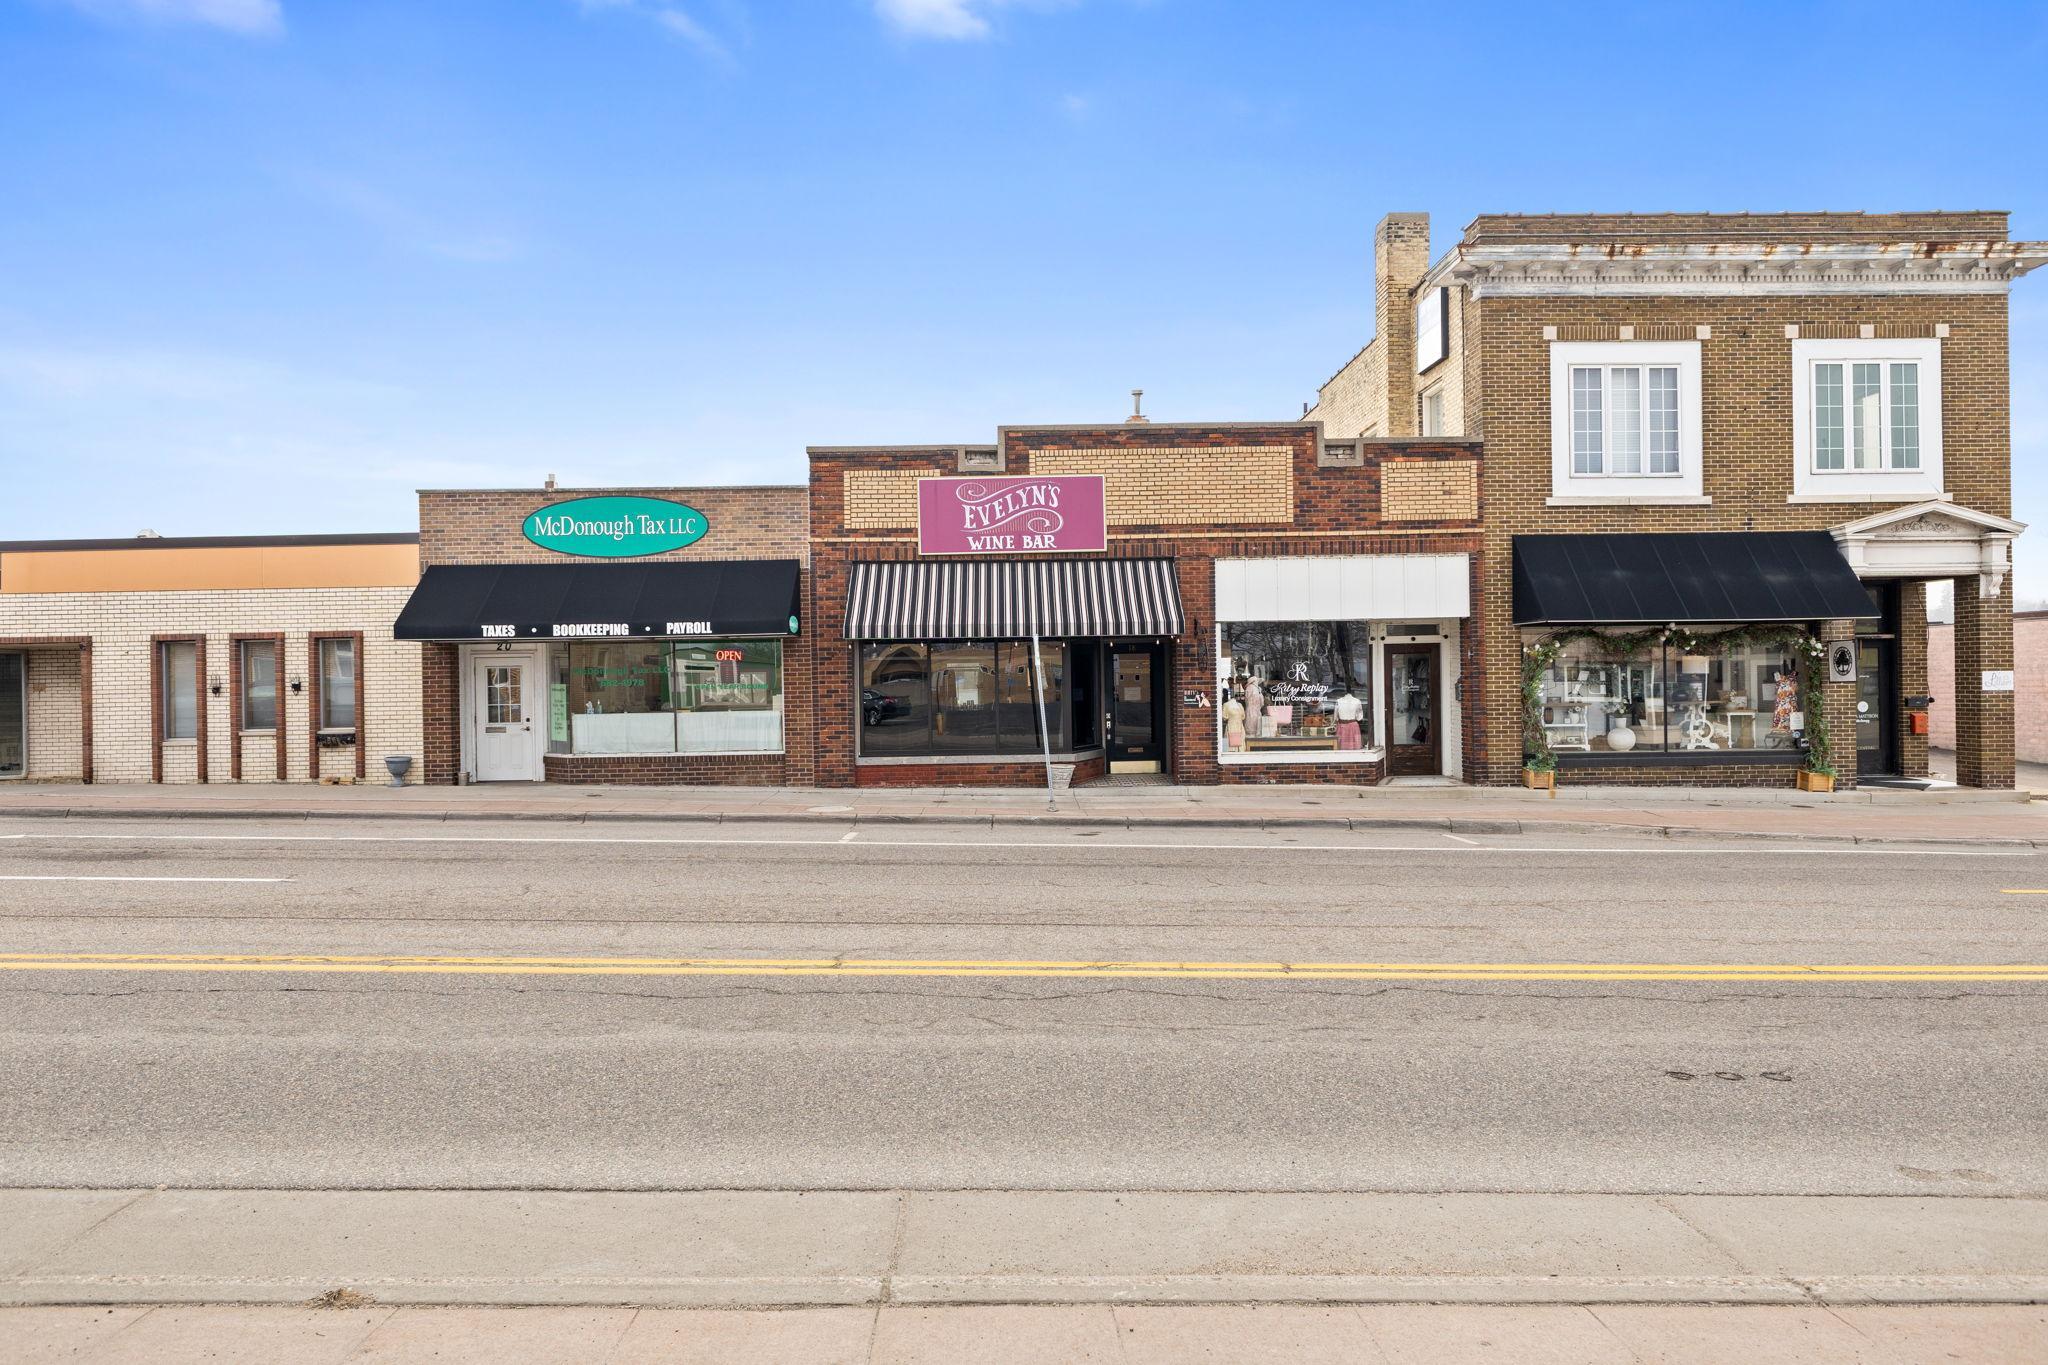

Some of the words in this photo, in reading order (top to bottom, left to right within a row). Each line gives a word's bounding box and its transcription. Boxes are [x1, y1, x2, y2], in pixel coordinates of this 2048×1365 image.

[962, 484, 1061, 529] EVELYN'S
[534, 515, 634, 541] McDonough
[636, 515, 666, 535] Tax
[669, 518, 696, 535] LLC
[967, 535, 1015, 550] WINE
[1022, 534, 1057, 549] BAR
[481, 625, 515, 637] TAXES
[552, 623, 629, 636] BOOKKEEPING
[666, 622, 712, 634] PAYROLL
[496, 642, 512, 651] 20
[715, 650, 742, 661] OPEN
[1300, 683, 1329, 695] Replay
